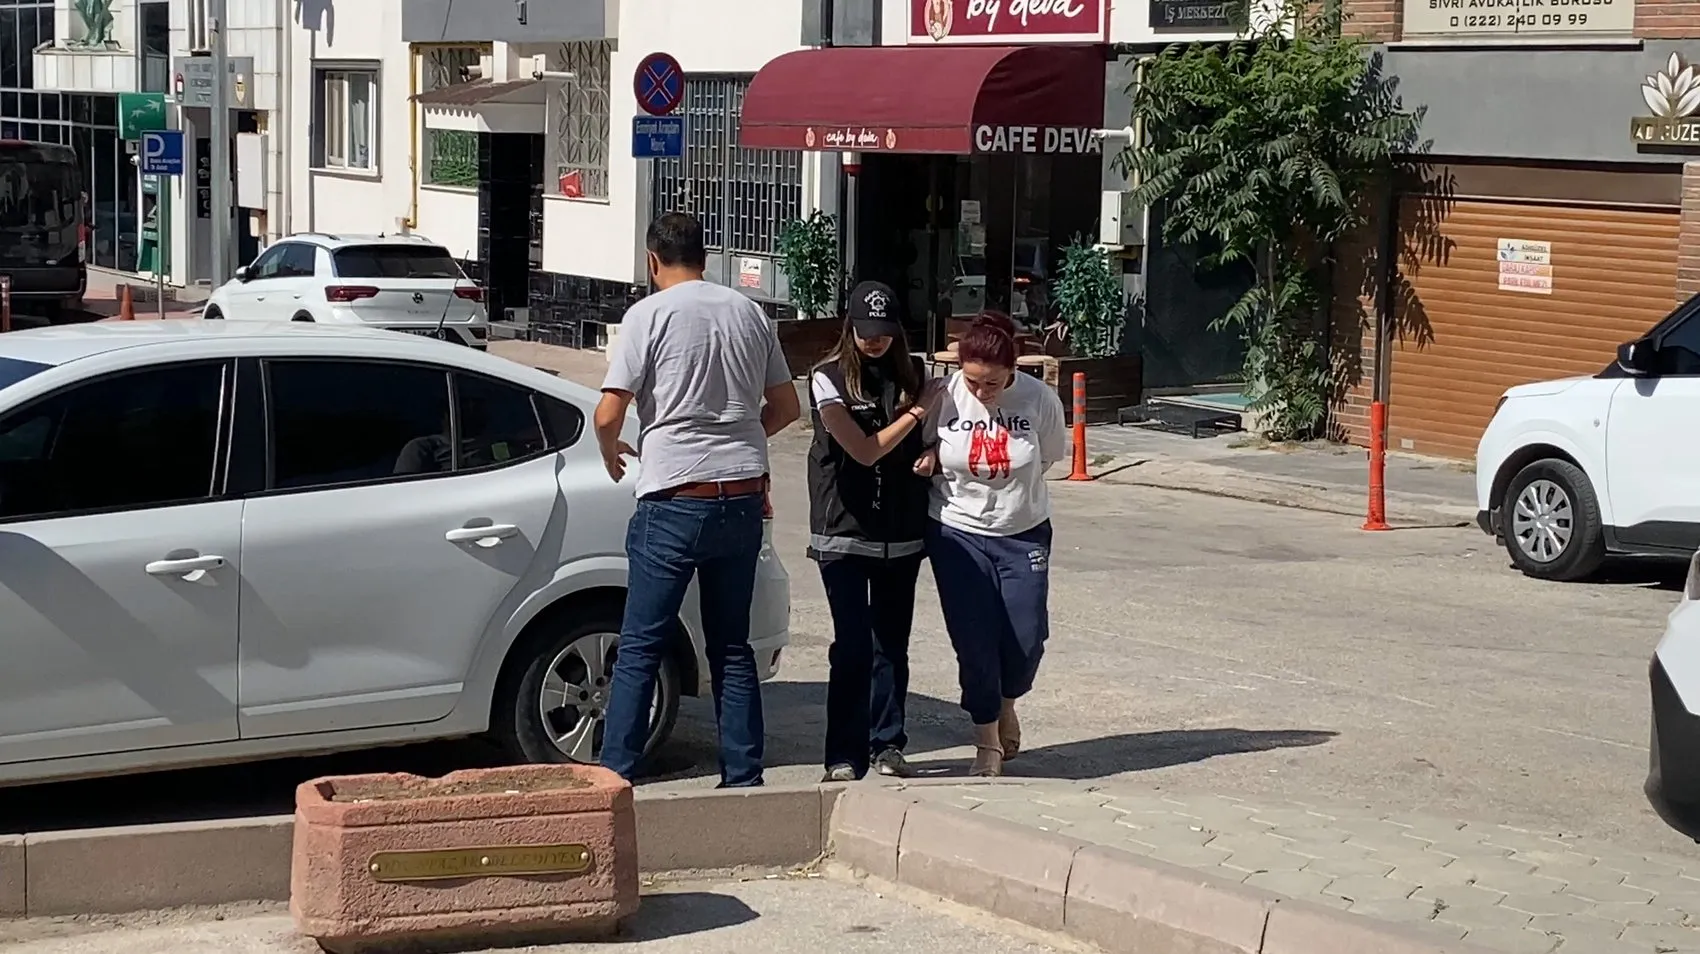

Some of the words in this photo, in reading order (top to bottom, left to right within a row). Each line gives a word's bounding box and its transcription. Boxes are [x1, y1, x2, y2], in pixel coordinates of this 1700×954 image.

[1464, 15, 1501, 27] (222)
[1506, 14, 1536, 27] 240
[1542, 14, 1562, 26] 09
[1568, 13, 1588, 26] 99
[975, 124, 1038, 152] CAFE
[1043, 127, 1101, 153] DEVA
[143, 133, 166, 170] P
[947, 417, 993, 432] Cool
